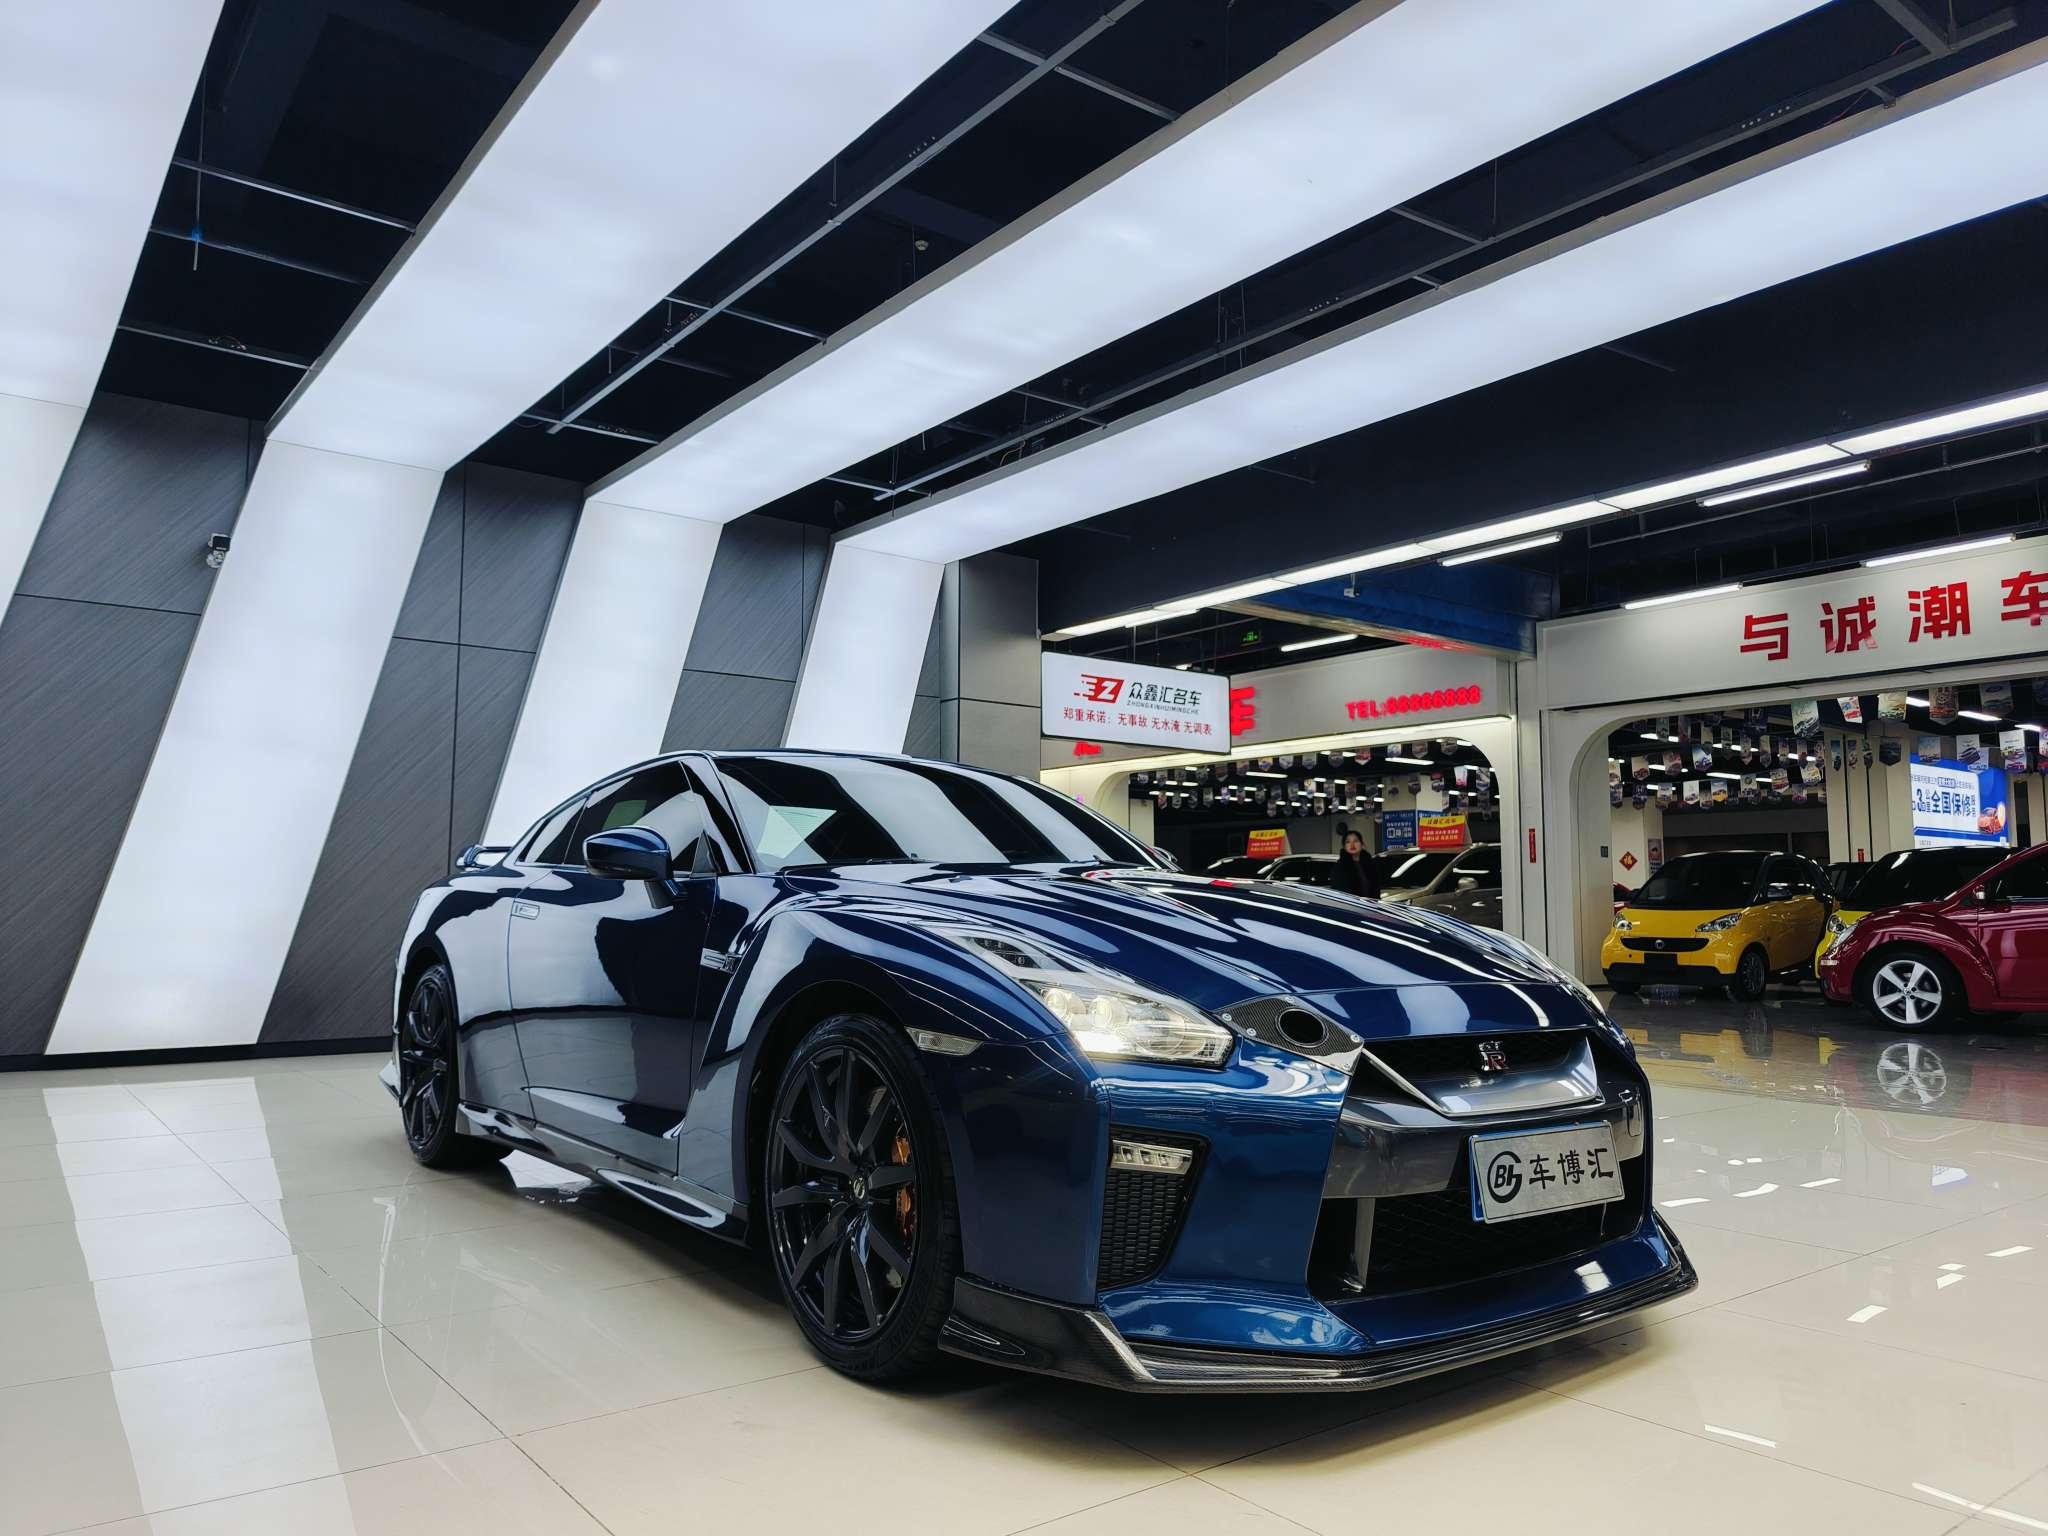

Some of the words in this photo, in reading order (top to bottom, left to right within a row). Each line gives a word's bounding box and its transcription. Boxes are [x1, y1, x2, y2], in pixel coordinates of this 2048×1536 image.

[1128, 682, 1202, 707] 众鑫汇名车
[1528, 1147, 1614, 1190] 车博汇
